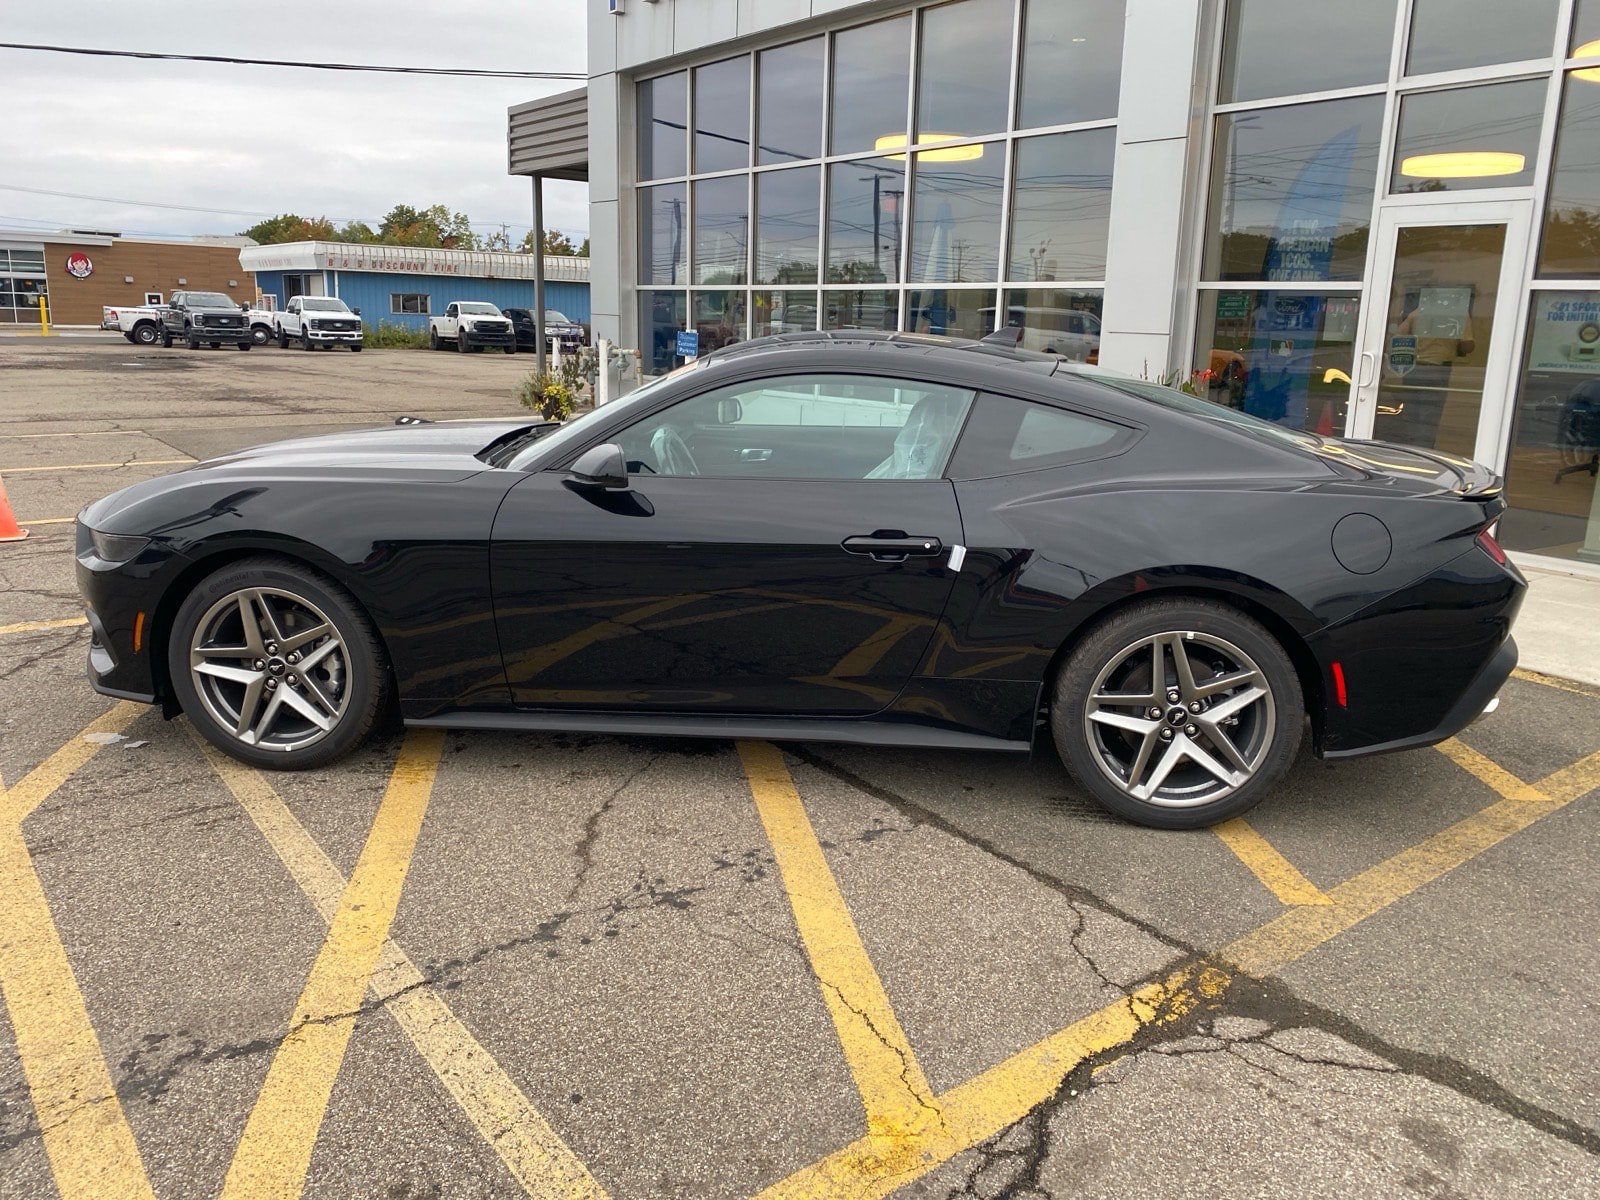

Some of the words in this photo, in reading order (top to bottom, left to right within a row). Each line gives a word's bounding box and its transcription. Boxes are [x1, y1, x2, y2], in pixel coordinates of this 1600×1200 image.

[328, 258, 334, 266] B
[371, 260, 426, 271] DISCOUNT
[433, 263, 459, 273] TIRE
[1547, 311, 1566, 321] FOR
[1567, 311, 1598, 322] INITIAL
[208, 572, 249, 593] Continental
